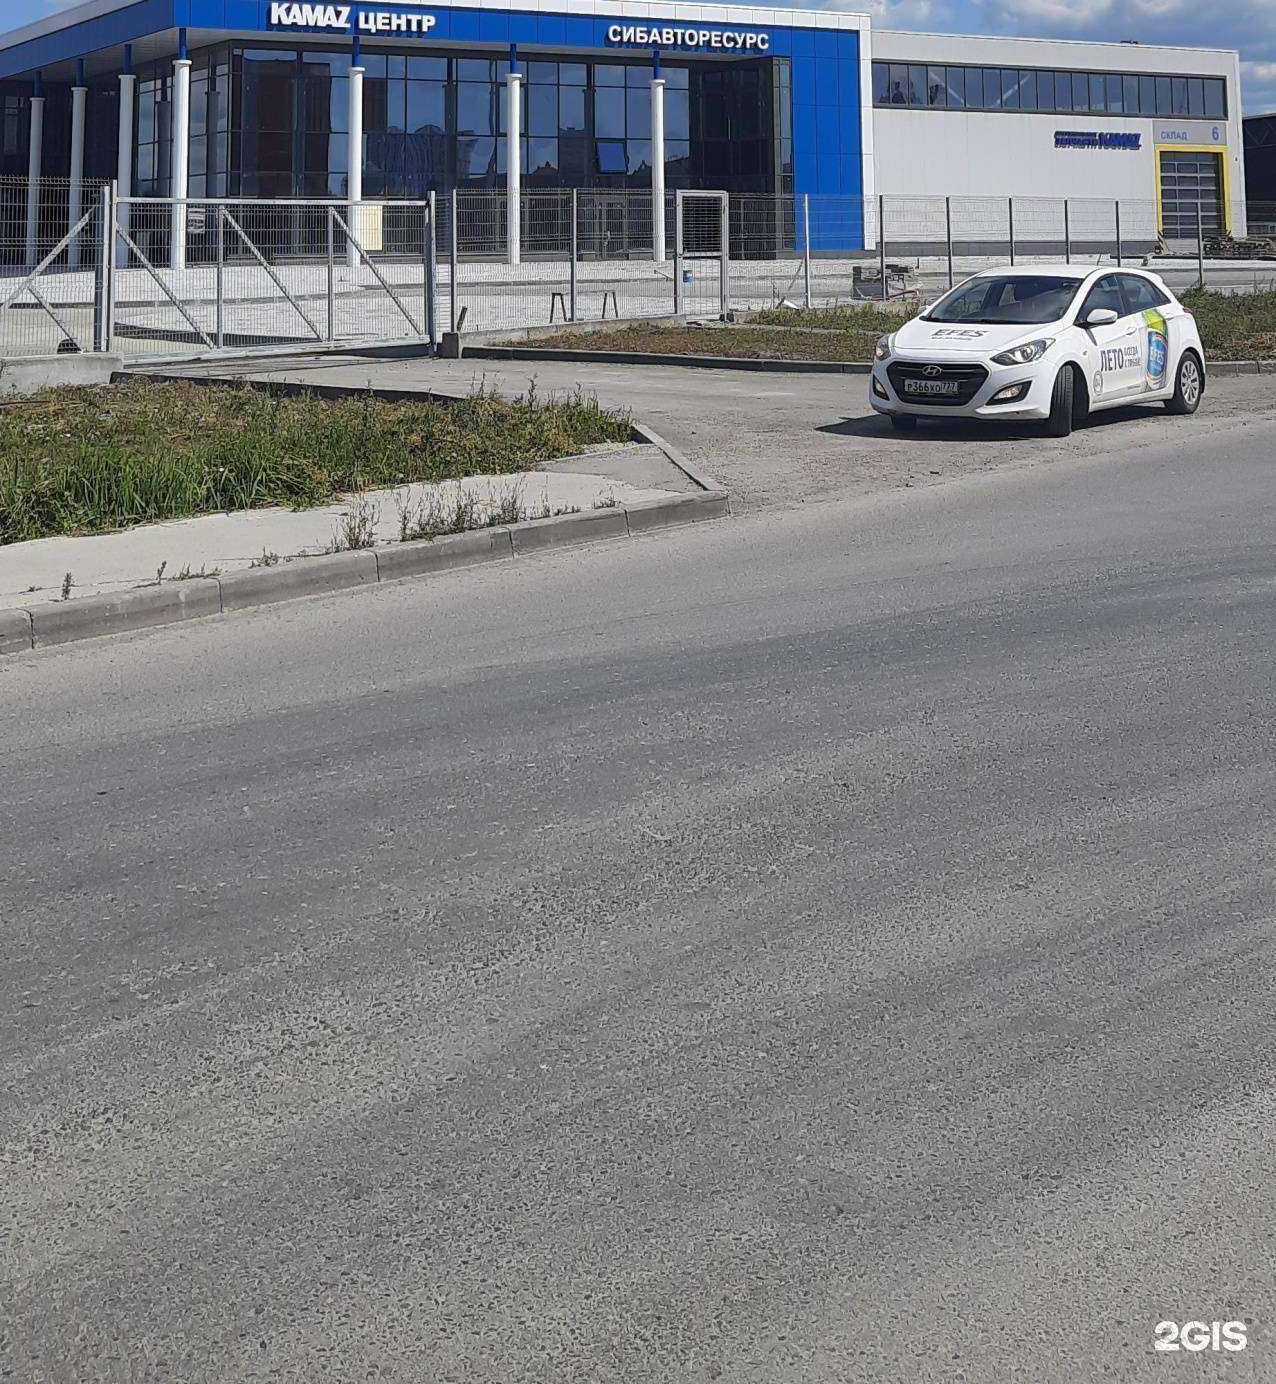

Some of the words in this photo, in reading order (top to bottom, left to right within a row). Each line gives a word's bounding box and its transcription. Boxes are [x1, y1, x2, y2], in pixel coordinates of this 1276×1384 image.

[270, 2, 350, 28] KAMAZ
[358, 11, 436, 33] ЦЕНТР
[608, 25, 769, 50] СИБАВТОРЕСУРС
[1160, 131, 1188, 141] СКЛАД
[1212, 127, 1219, 140] 6
[1100, 347, 1124, 372] ЛЕТО
